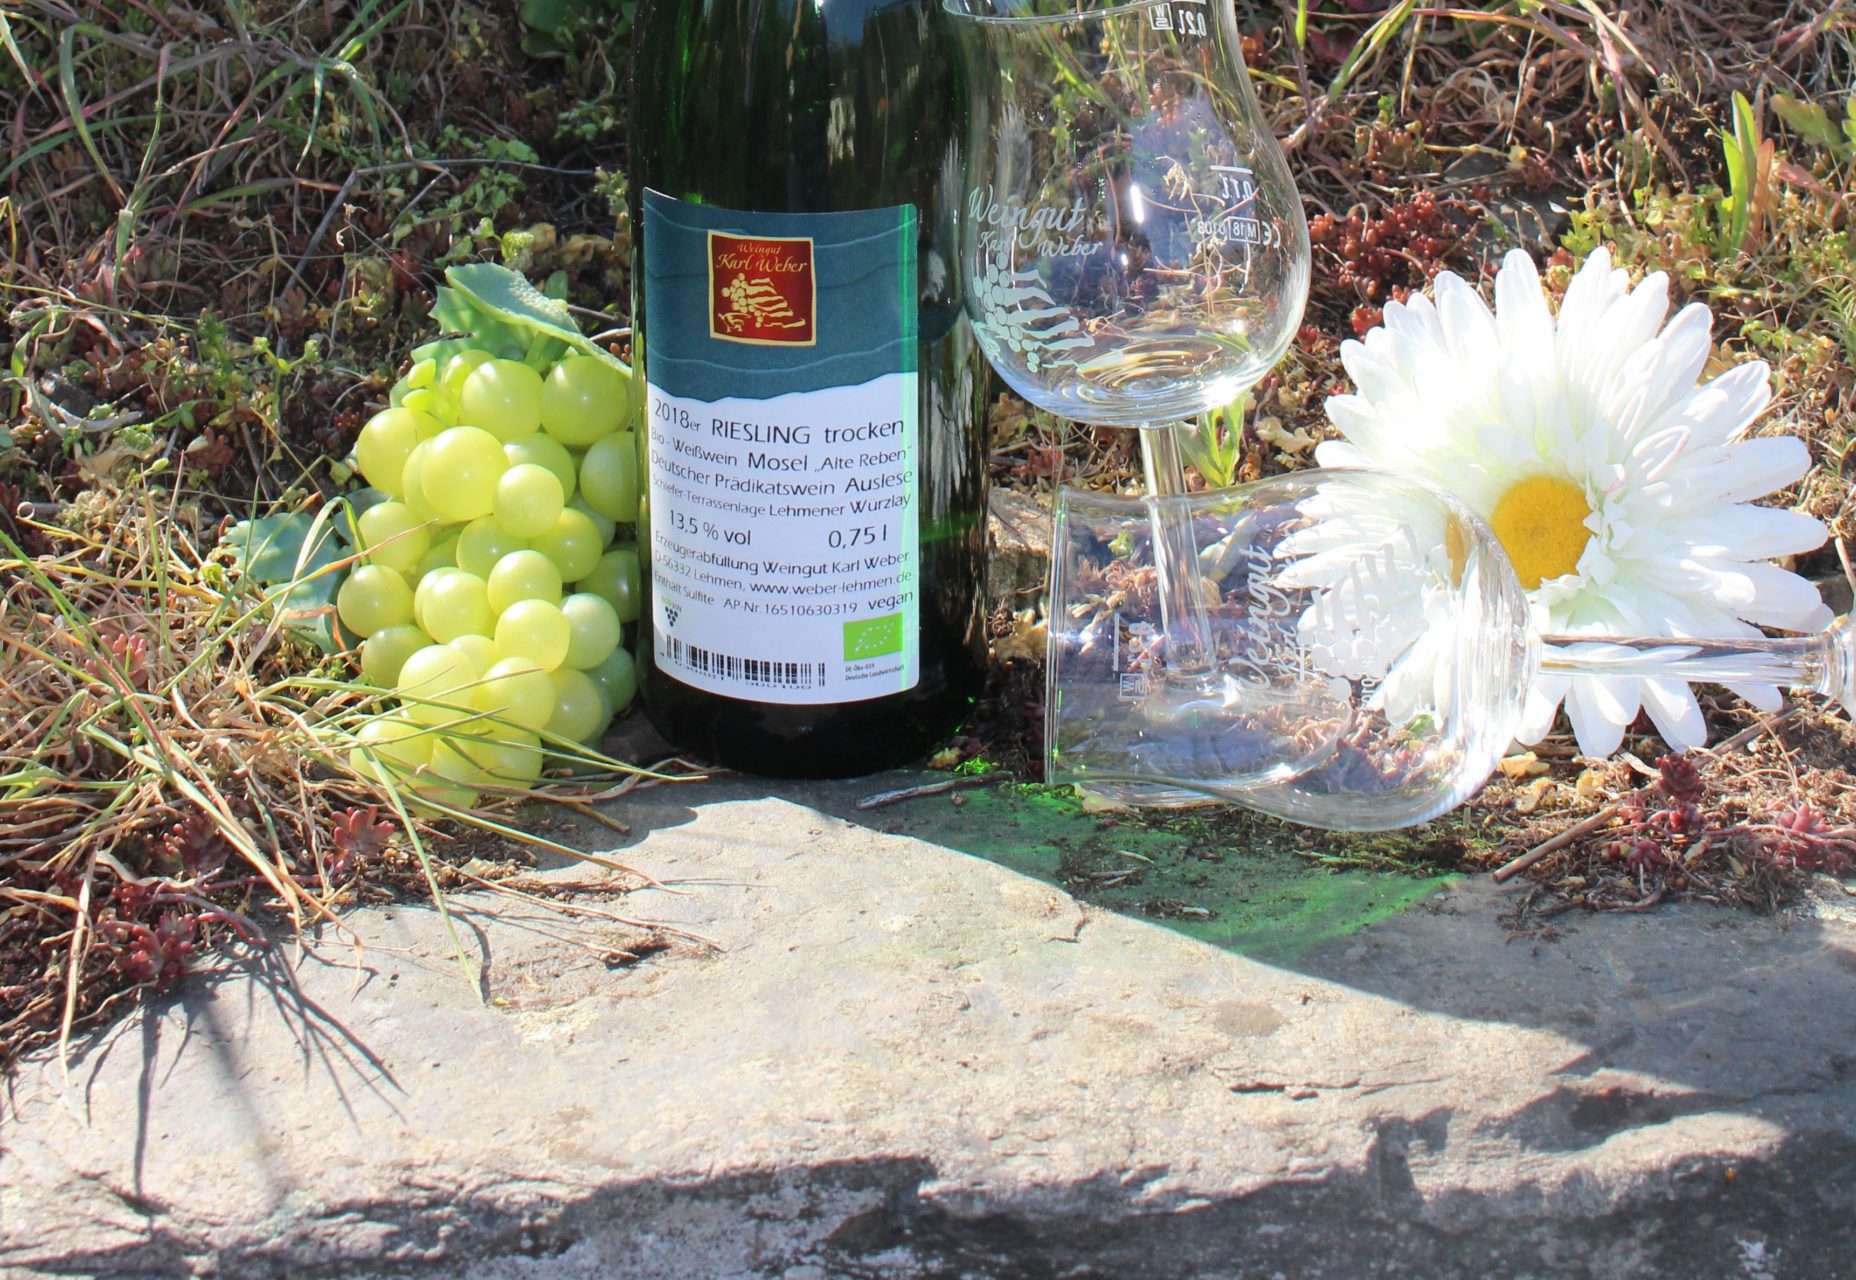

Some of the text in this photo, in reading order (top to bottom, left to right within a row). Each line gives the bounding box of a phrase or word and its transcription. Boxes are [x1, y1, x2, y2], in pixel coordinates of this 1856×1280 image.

[968, 183, 1087, 249] Weingut
[715, 252, 808, 273] Karl Weber
[737, 243, 782, 257] Weingut
[977, 231, 1104, 258] Karl Weber
[654, 398, 905, 445] 2018er RIESLING trocken
[651, 426, 665, 444] Bio
[672, 437, 738, 467] Weißwein
[747, 451, 809, 472] Mosel
[651, 449, 913, 497] Deutscher Prädikatswein Auslese
[652, 474, 912, 519] Schiefer-Terrassenlage Lehmener Würzlay
[669, 508, 698, 535] 13,5
[702, 521, 719, 541] %
[723, 530, 752, 546] vol
[828, 524, 876, 550] 0,75
[654, 549, 913, 596] D-56332 Lehmen, www.weber-lehmen.de
[655, 530, 910, 579] Erzeugerabfüllung Weingut Karl Weber
[653, 570, 681, 595] Enthält
[683, 585, 715, 606] Sulfite
[867, 590, 914, 611] vegan
